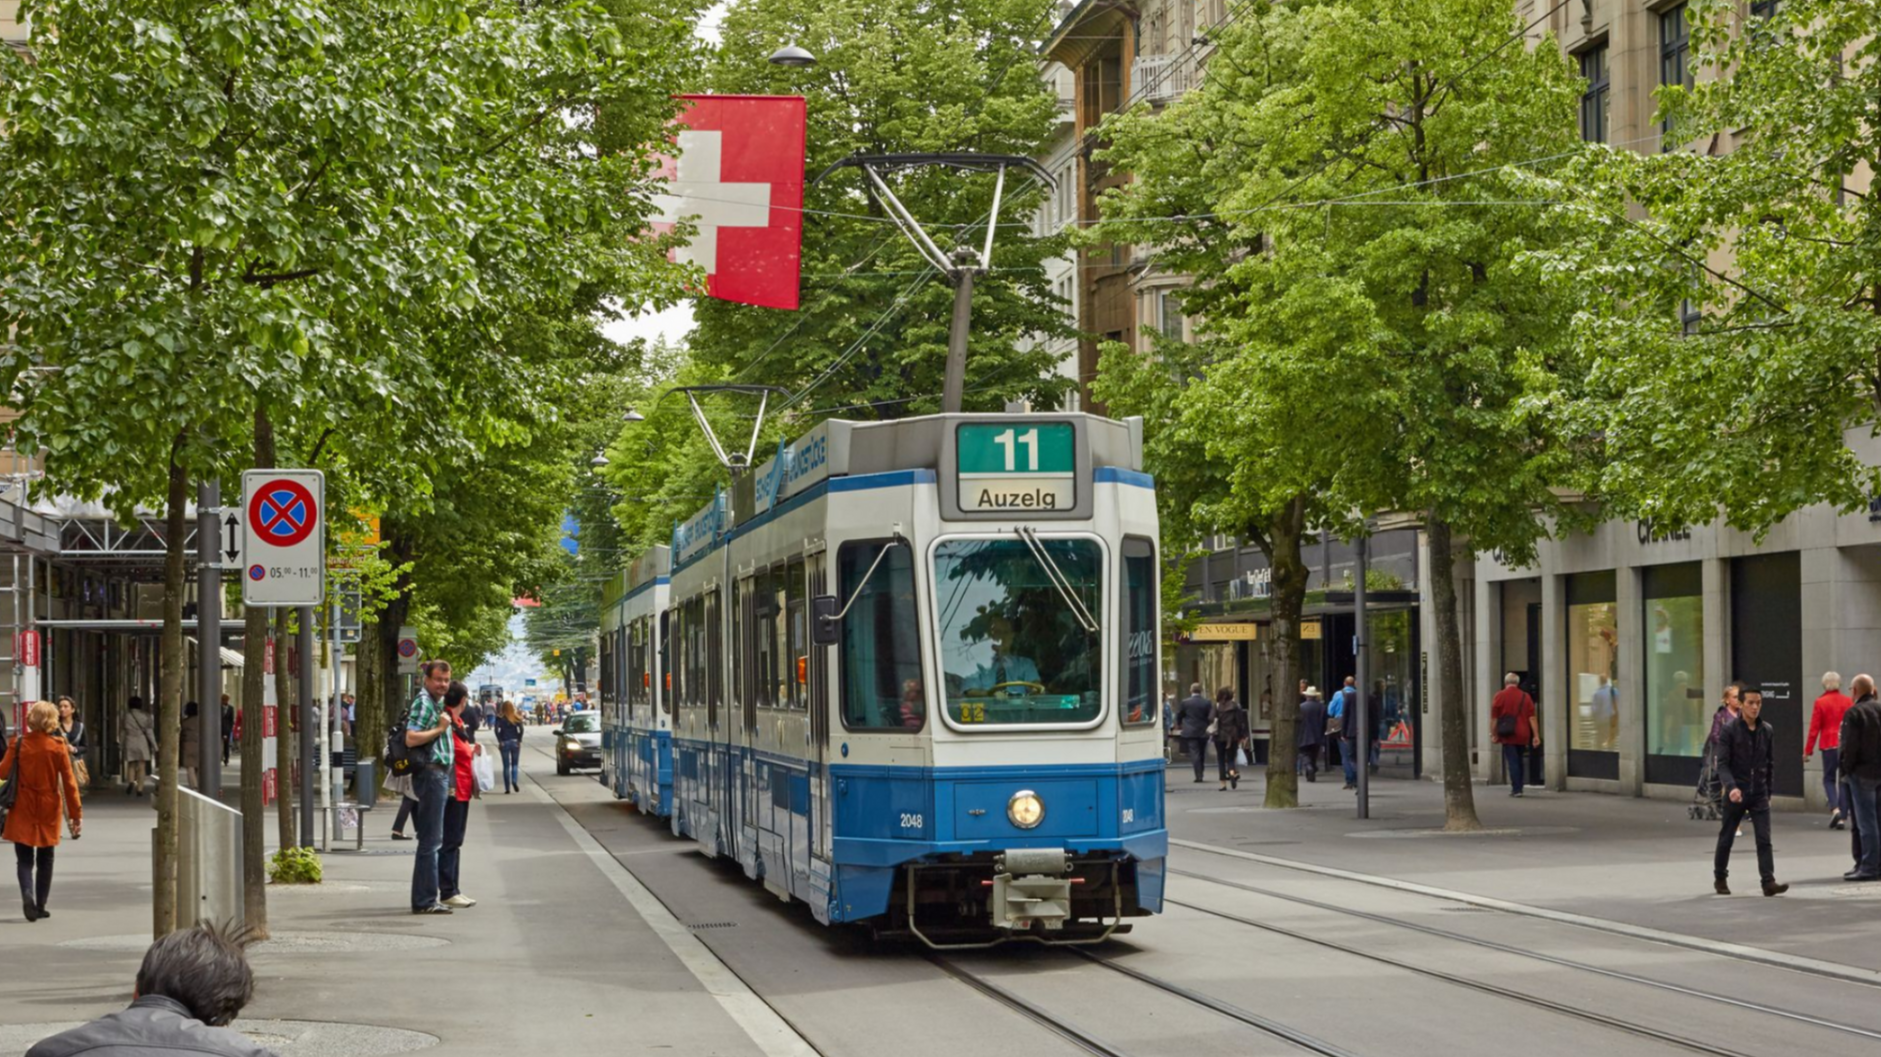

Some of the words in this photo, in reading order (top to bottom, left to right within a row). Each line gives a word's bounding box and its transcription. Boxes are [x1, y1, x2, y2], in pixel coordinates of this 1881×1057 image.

[993, 428, 1039, 471] 11
[978, 487, 1056, 510] Auzelg
[1200, 625, 1212, 634] EN
[1215, 625, 1249, 634] VOGUE
[900, 812, 923, 829] 2048
